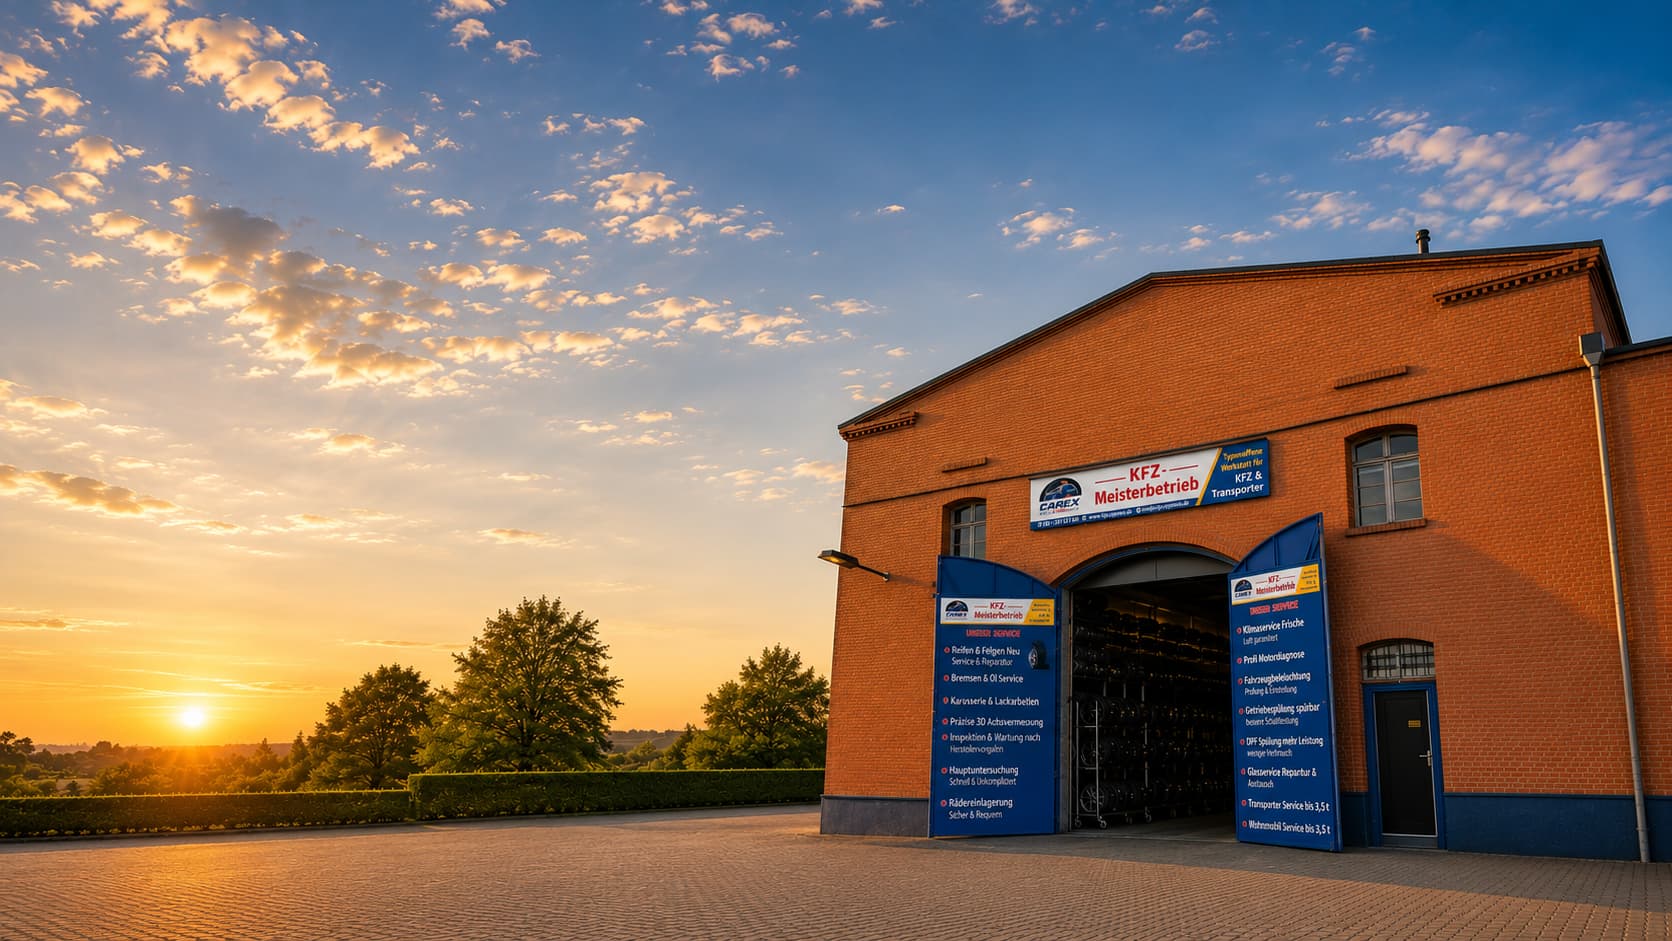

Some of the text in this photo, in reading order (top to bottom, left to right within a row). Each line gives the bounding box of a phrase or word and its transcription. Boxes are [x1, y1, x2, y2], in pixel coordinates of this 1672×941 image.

[1235, 470, 1263, 484] KFZ &
[1094, 475, 1199, 506] Meisterbetrieb
[1211, 483, 1264, 498] Transporter
[1039, 497, 1081, 512] CAREX
[974, 611, 1023, 620] Meisterbetrieb
[951, 645, 975, 655] Reifen
[982, 646, 1006, 657] Felgen
[1006, 647, 1021, 656] Neu
[1258, 651, 1305, 662] Motordiagnose
[951, 656, 975, 666] Service
[951, 673, 981, 682] Bremsen
[983, 673, 989, 682] &
[998, 673, 1024, 683] Service
[950, 733, 986, 743] Inspektion
[994, 732, 1023, 743] Wartung
[1282, 736, 1298, 746] mehr
[949, 766, 1019, 776] Hauptuntersuchung
[1311, 767, 1317, 777] &
[1247, 798, 1330, 813] Transporter Service bis 3,5 t
[1282, 822, 1304, 833] Service
[1304, 823, 1315, 834] bis
[1315, 824, 1327, 836] 3,5
